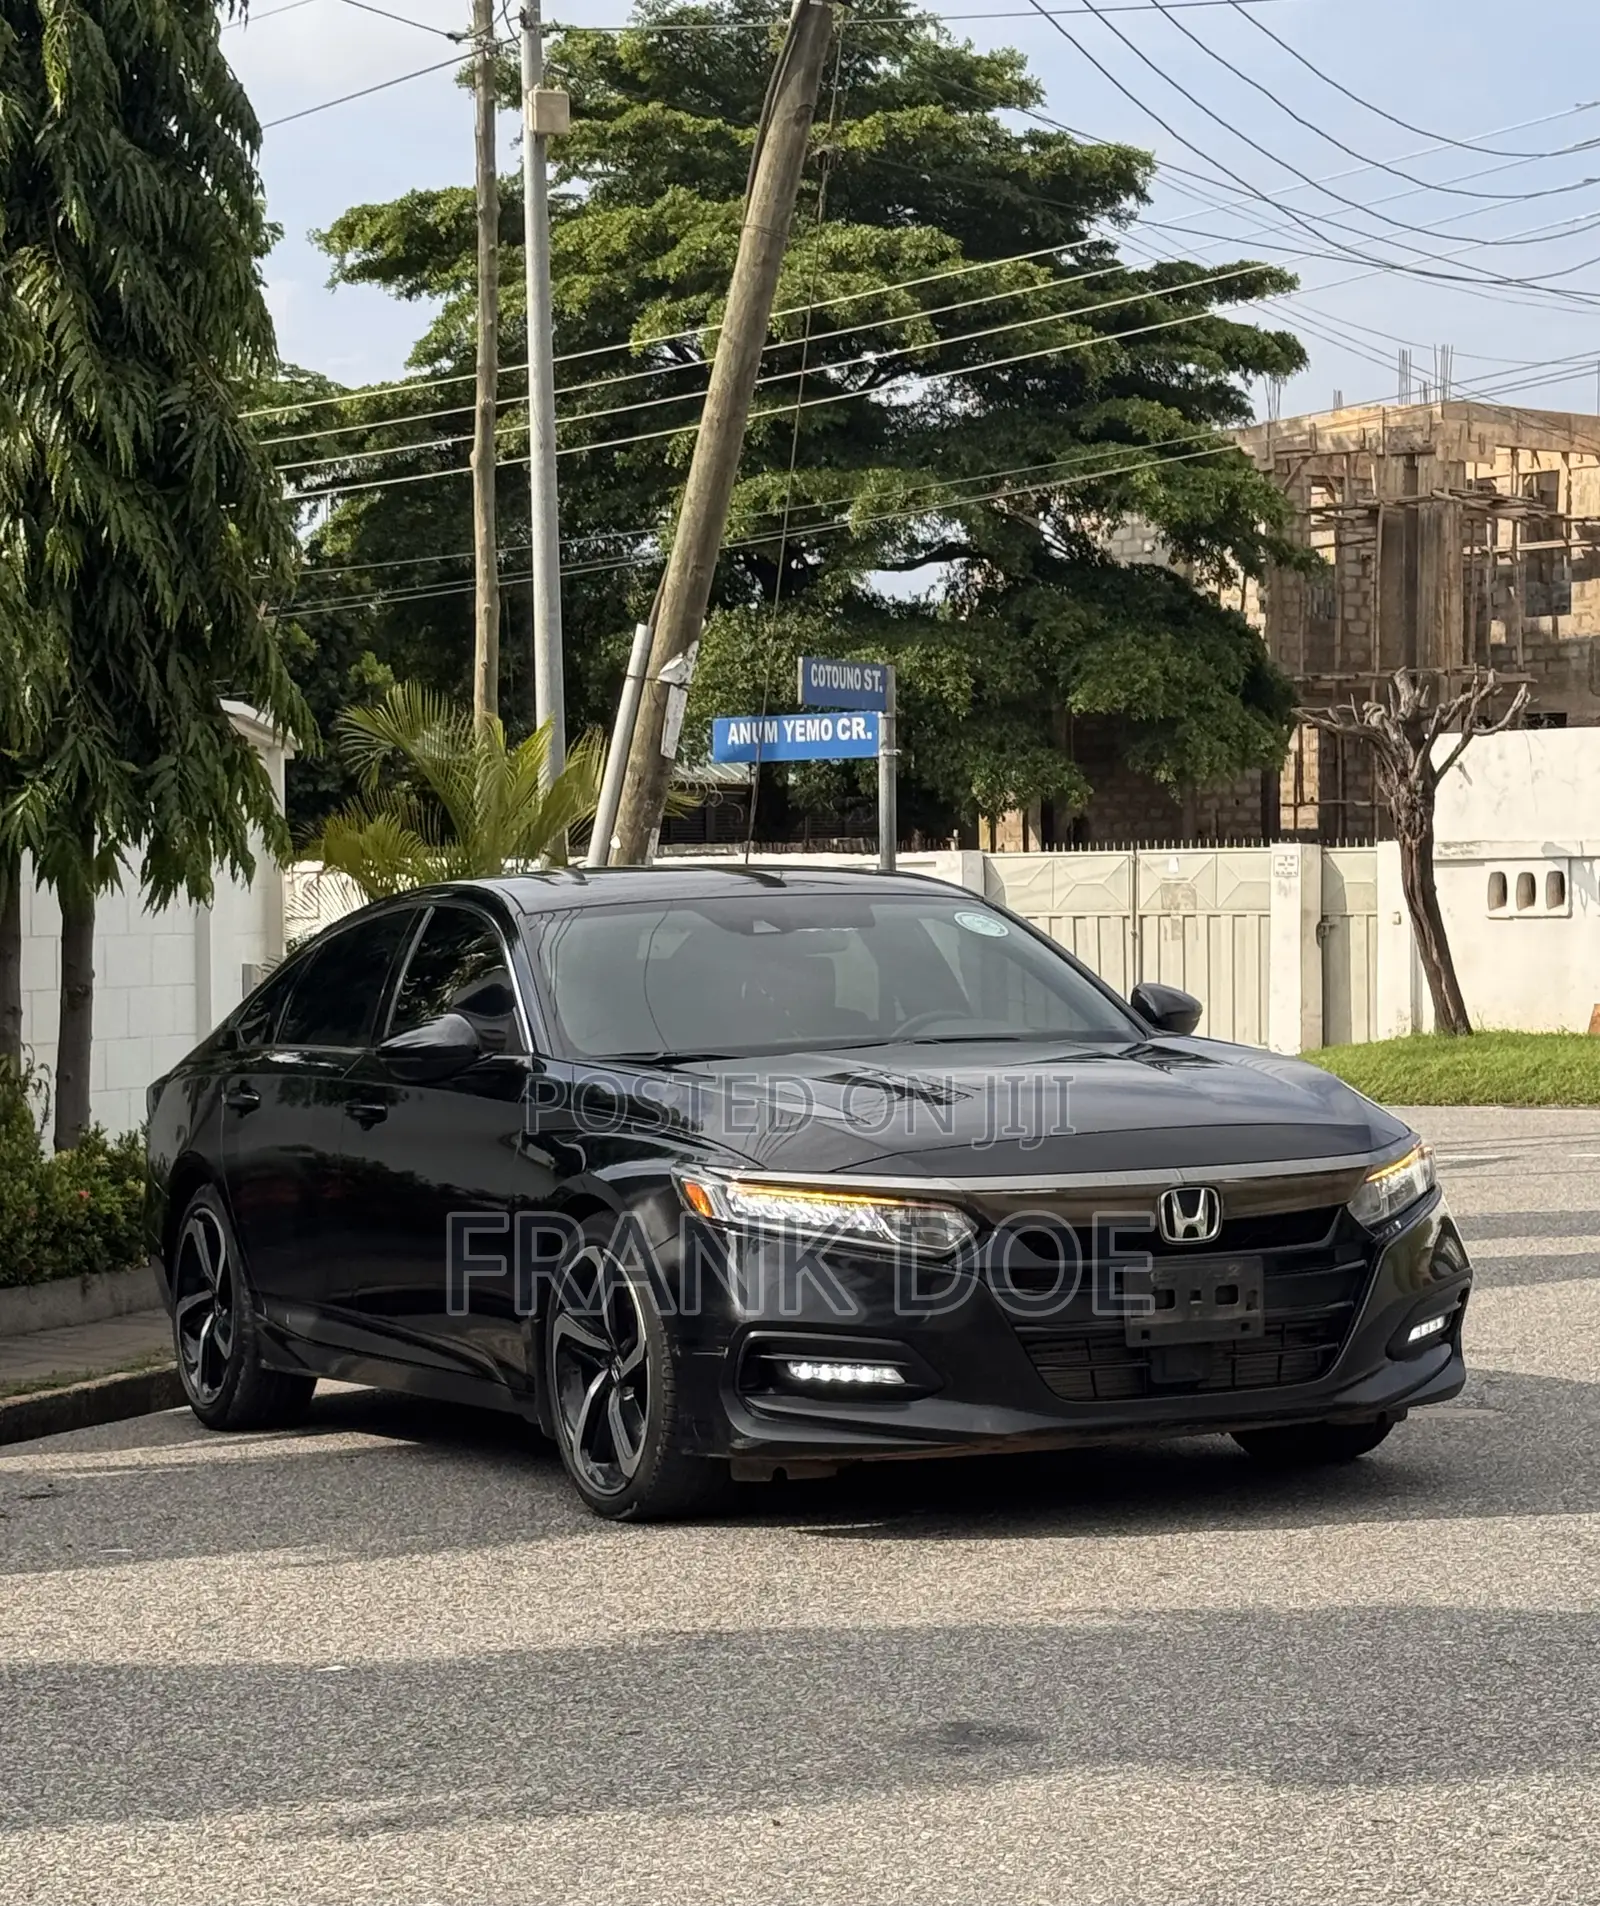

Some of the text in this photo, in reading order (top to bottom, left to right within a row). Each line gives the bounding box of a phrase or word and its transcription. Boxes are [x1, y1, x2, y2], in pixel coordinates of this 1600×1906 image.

[810, 663, 883, 693] COTOUNO ST.
[727, 717, 873, 745] ANUM YEMO CR.
